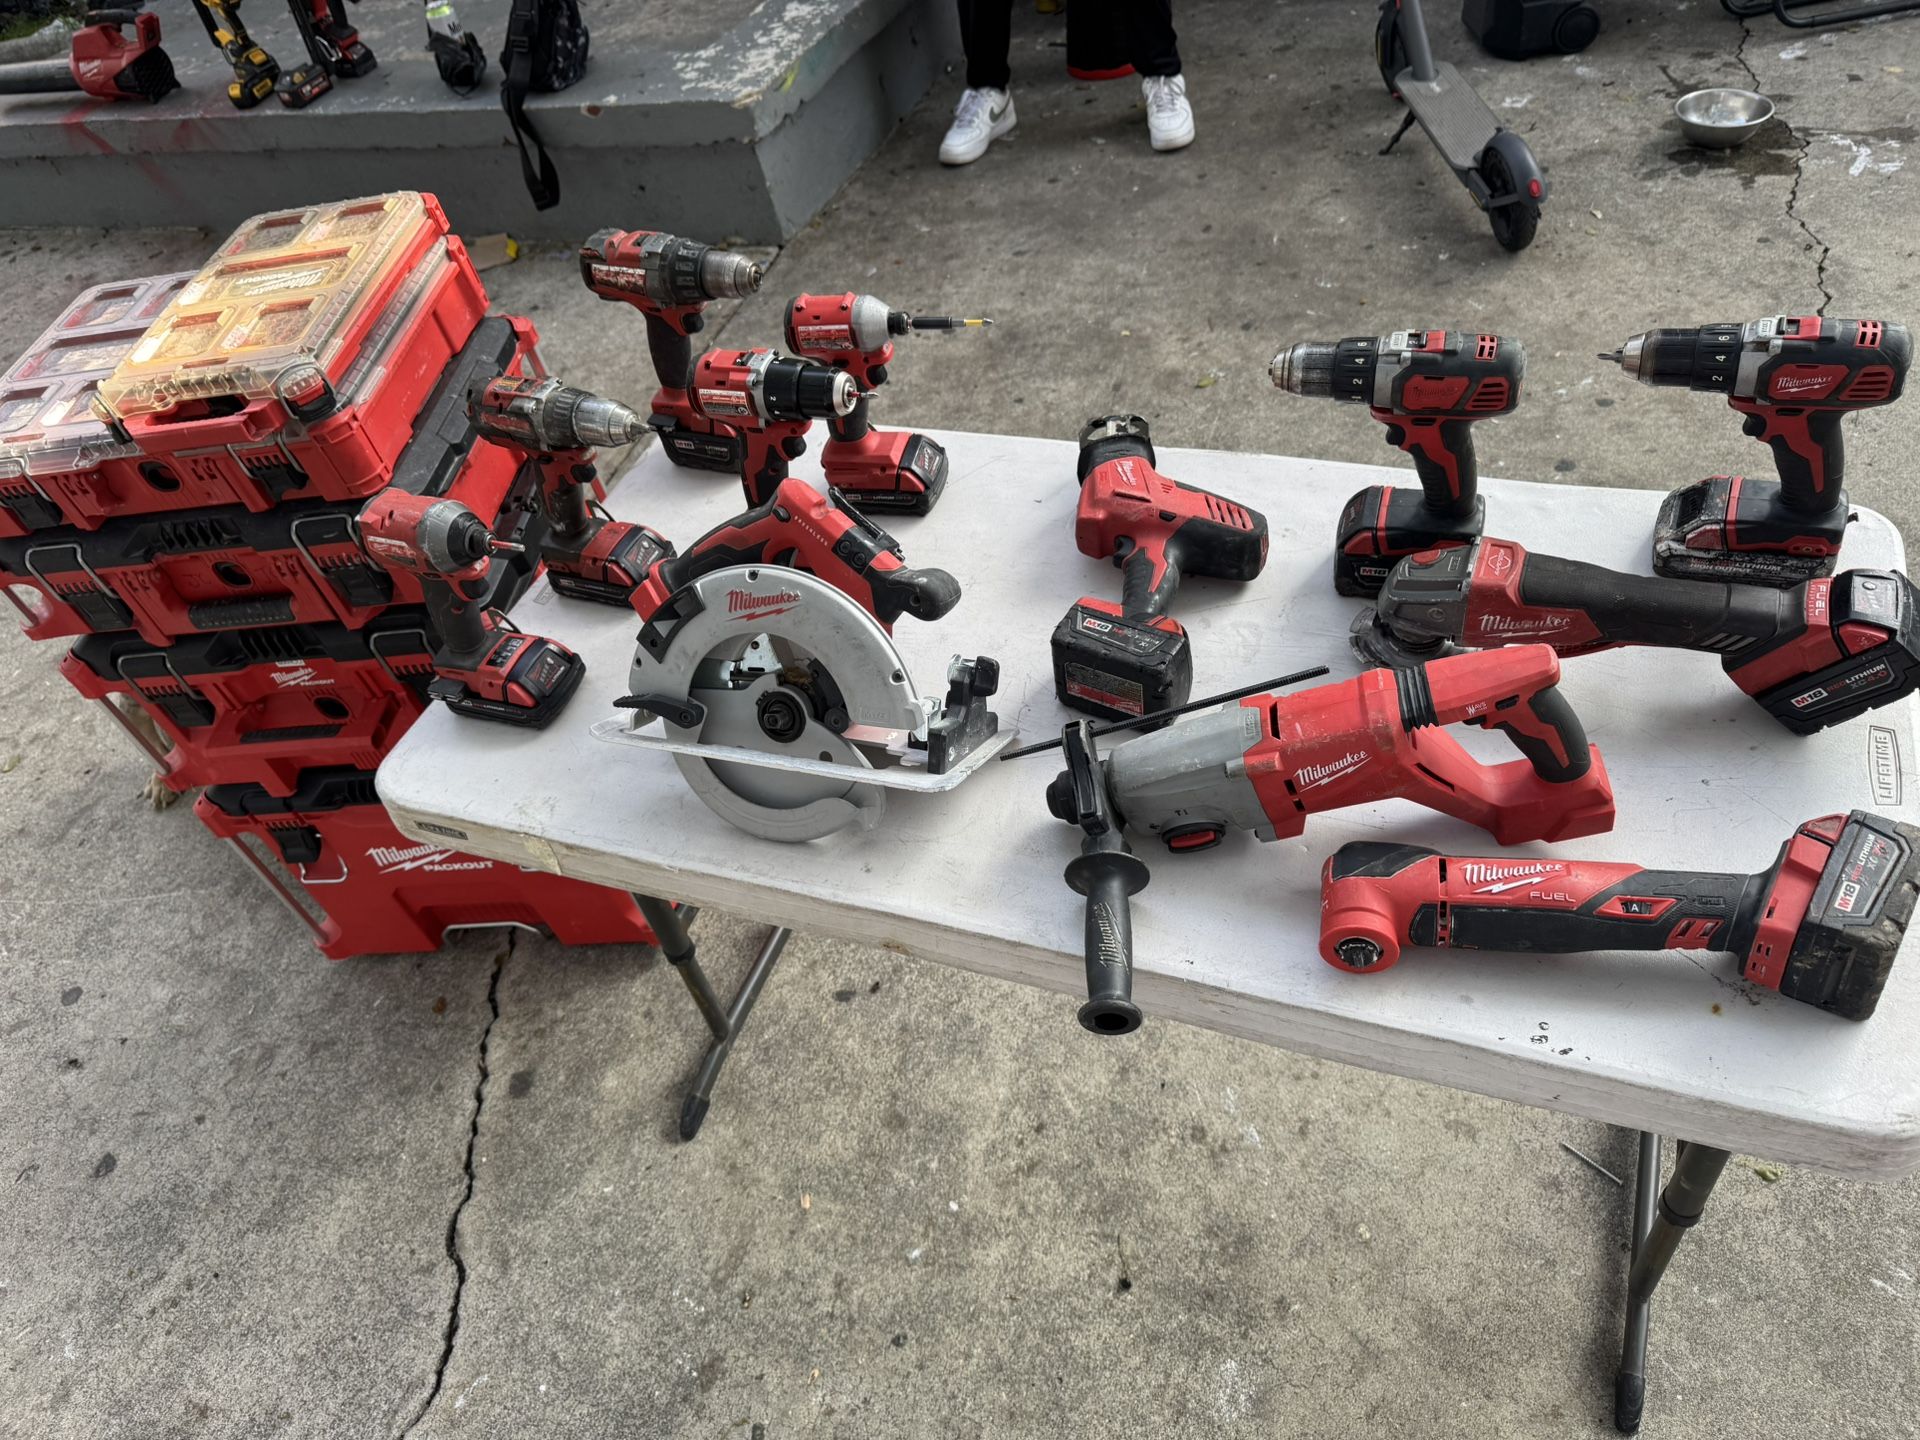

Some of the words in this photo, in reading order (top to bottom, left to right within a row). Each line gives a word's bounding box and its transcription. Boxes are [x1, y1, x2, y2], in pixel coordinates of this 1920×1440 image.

[244, 272, 323, 297] Milwaukee
[1777, 376, 1832, 390] Milwaukee
[725, 587, 801, 613] Milwaukee
[1815, 584, 1827, 616] FUEL
[1086, 619, 1110, 631] M18
[1479, 614, 1570, 631] Milwaukee
[1795, 690, 1824, 706] M18
[1293, 750, 1368, 786] Milwaukee
[1875, 735, 1892, 798] LIFETIME
[365, 844, 446, 867] Milwau
[422, 860, 494, 872] PACKOUT
[1464, 862, 1562, 885] Milwaukee
[1530, 891, 1577, 902] FUEL
[1631, 903, 1639, 912] A
[1837, 883, 1856, 910] M18
[1094, 902, 1122, 967] Milwaukee
